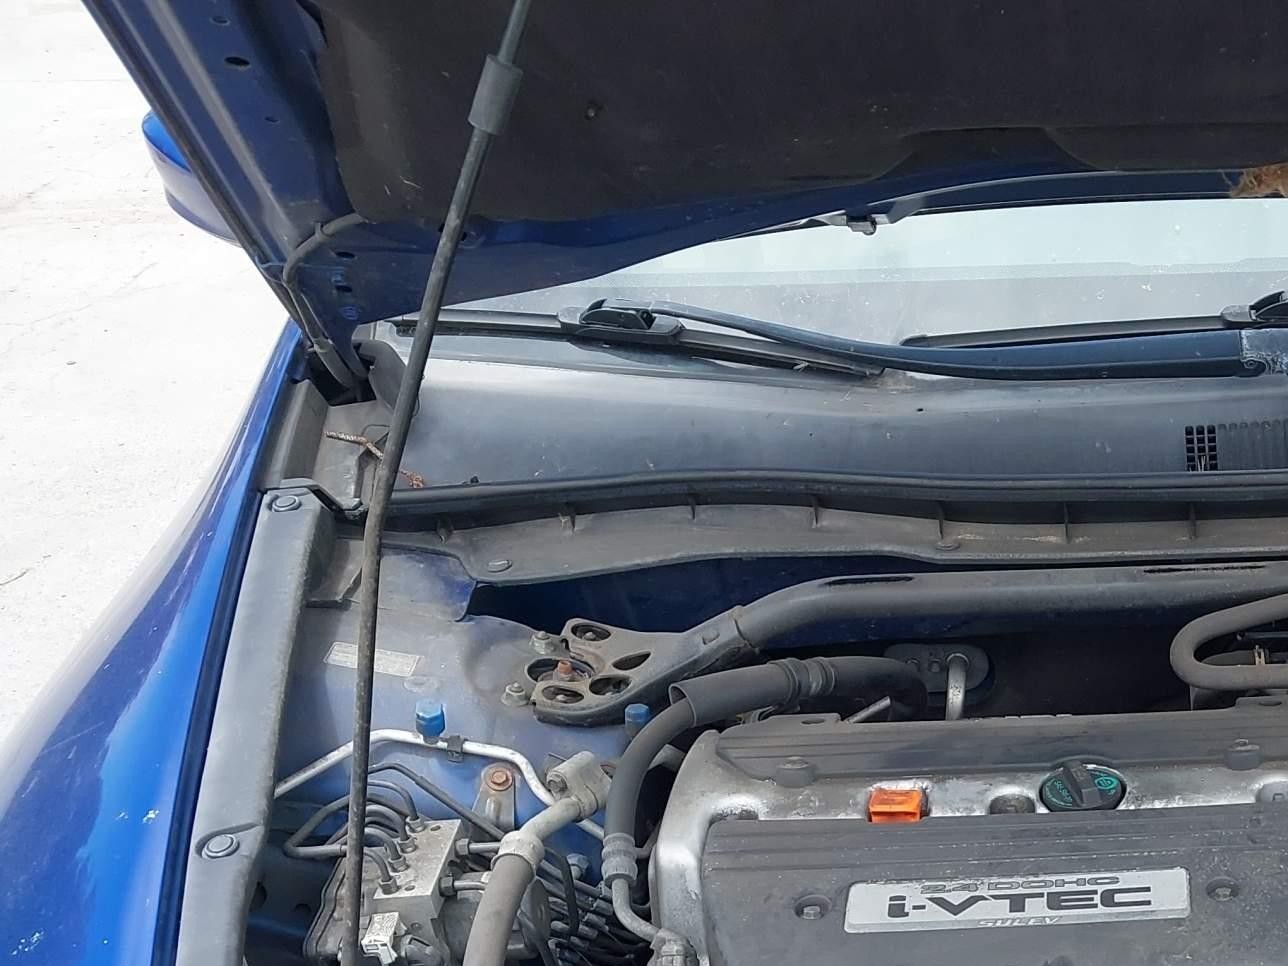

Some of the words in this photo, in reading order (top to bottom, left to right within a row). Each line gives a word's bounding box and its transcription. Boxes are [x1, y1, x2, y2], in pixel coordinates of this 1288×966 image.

[920, 882, 980, 895] 2.4
[987, 876, 1120, 891] DOHC
[887, 886, 1152, 919] i-VTEC
[977, 915, 1061, 928] SULEV
